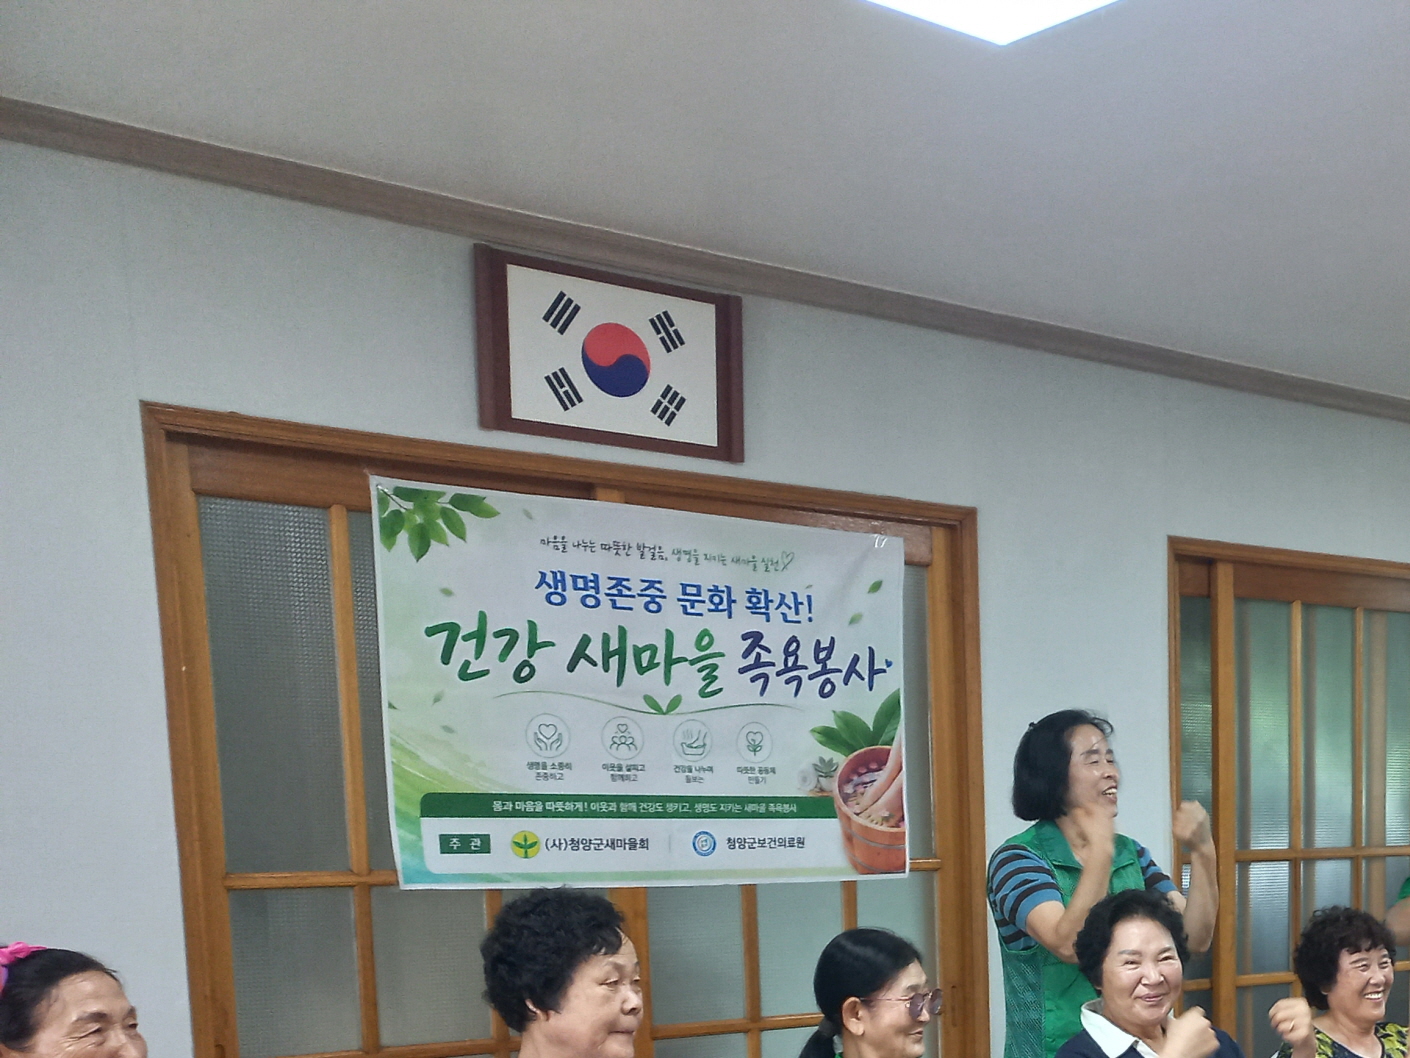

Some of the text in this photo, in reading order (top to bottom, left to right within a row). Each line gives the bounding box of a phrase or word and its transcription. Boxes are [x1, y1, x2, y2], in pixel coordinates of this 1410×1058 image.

[540, 535, 568, 553] 마음을
[572, 539, 597, 552] 나누는
[600, 540, 632, 556] 따뜻한
[534, 569, 814, 624] 생명존중 문화 확산!
[424, 610, 888, 699] 건강 새마을 족욕봉사
[492, 800, 513, 812] 몸과
[514, 801, 543, 812] 마음을
[545, 801, 588, 812] 따뜻하게!
[590, 801, 617, 812] 이웃과
[638, 802, 665, 813] 건강도
[694, 802, 718, 813] 생명도
[719, 802, 743, 813] 지키는
[544, 837, 650, 851] (사)청양군새마을회
[726, 836, 805, 850] 청양군보건의료원
